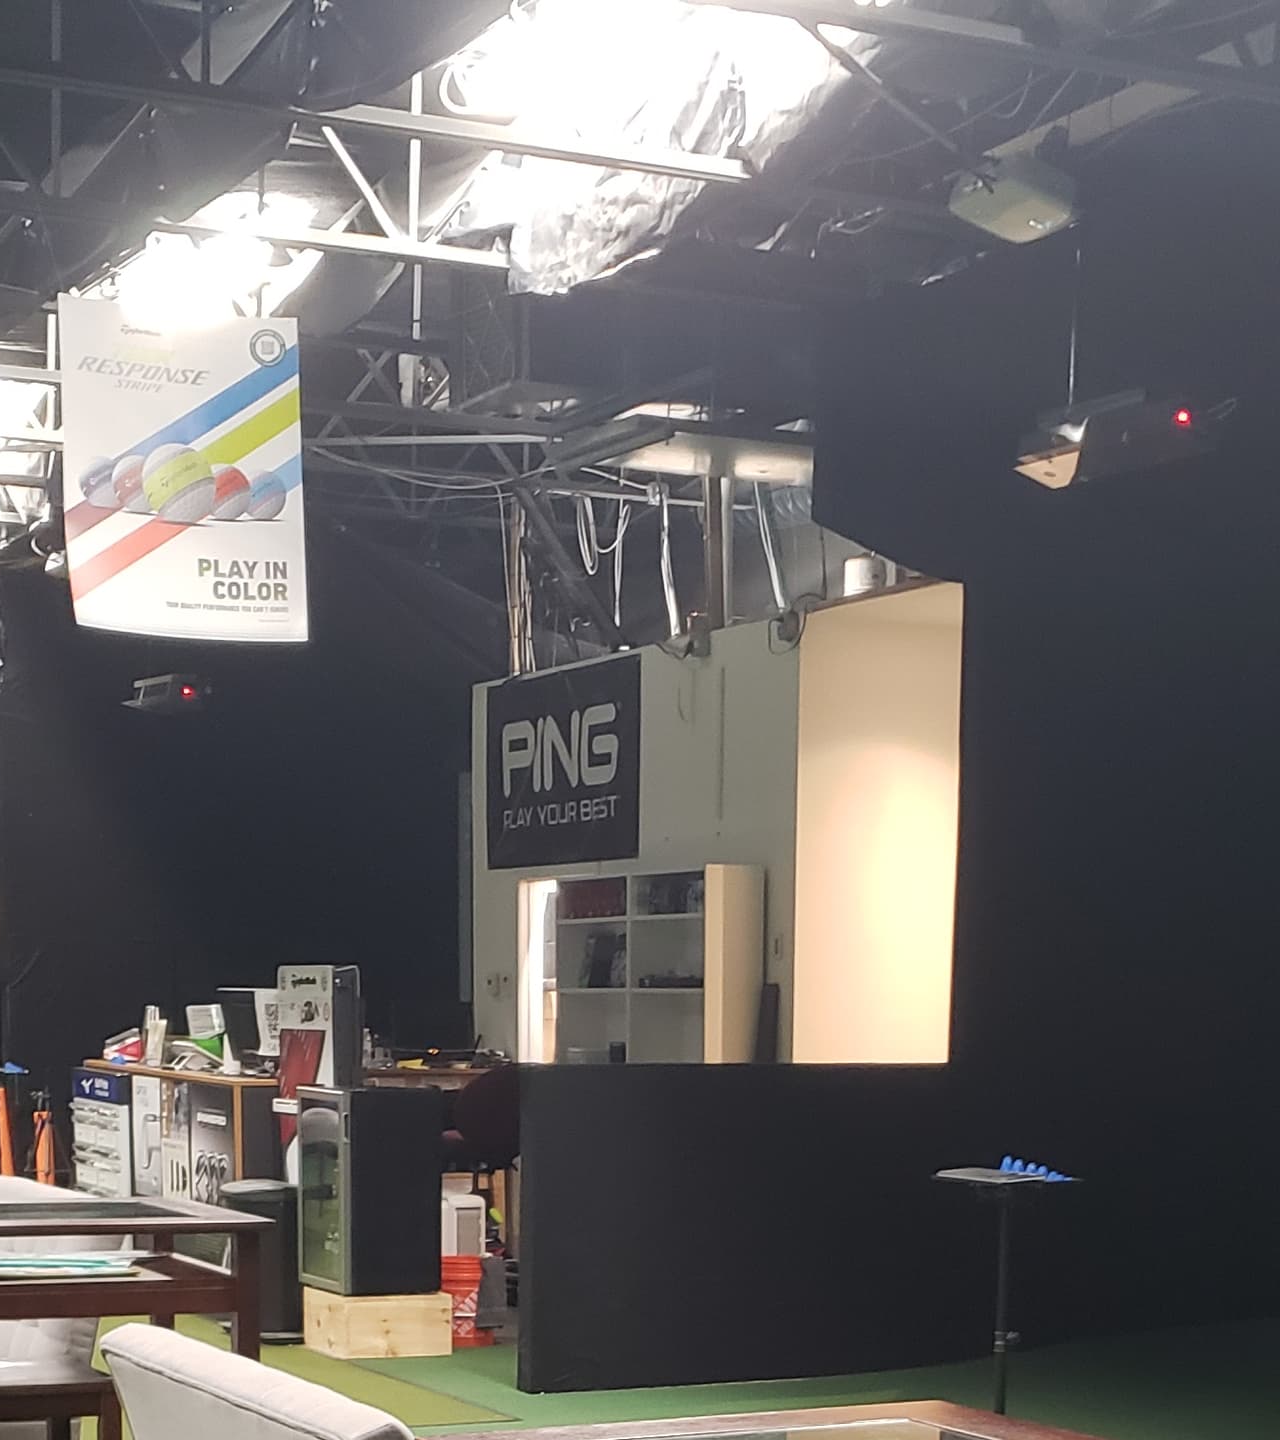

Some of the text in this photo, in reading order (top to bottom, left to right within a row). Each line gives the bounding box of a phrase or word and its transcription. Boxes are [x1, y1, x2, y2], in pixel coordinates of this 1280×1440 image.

[77, 355, 210, 386] RESPONSE
[198, 558, 288, 579] PLAY IN
[213, 580, 288, 601] COLOR
[502, 702, 619, 798] PING
[503, 795, 618, 829] PLAY YOUR BEST
